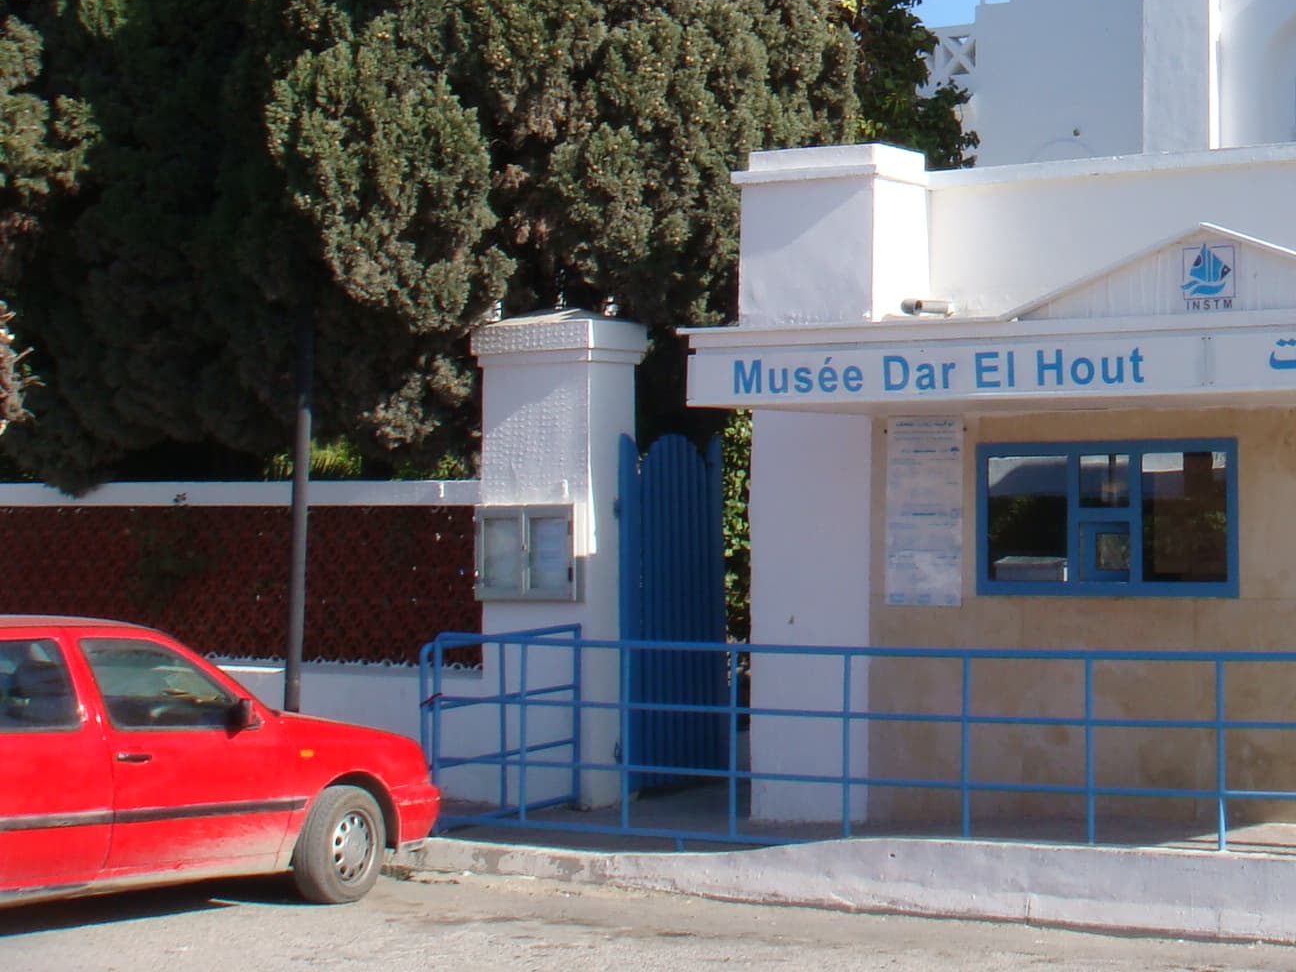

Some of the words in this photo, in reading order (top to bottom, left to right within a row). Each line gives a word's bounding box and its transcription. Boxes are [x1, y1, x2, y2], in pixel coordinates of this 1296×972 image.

[1186, 299, 1233, 310] INSTM
[733, 356, 864, 395] Musée
[883, 355, 957, 392] Dar
[974, 350, 1016, 389] El
[1036, 347, 1145, 386] Hout
